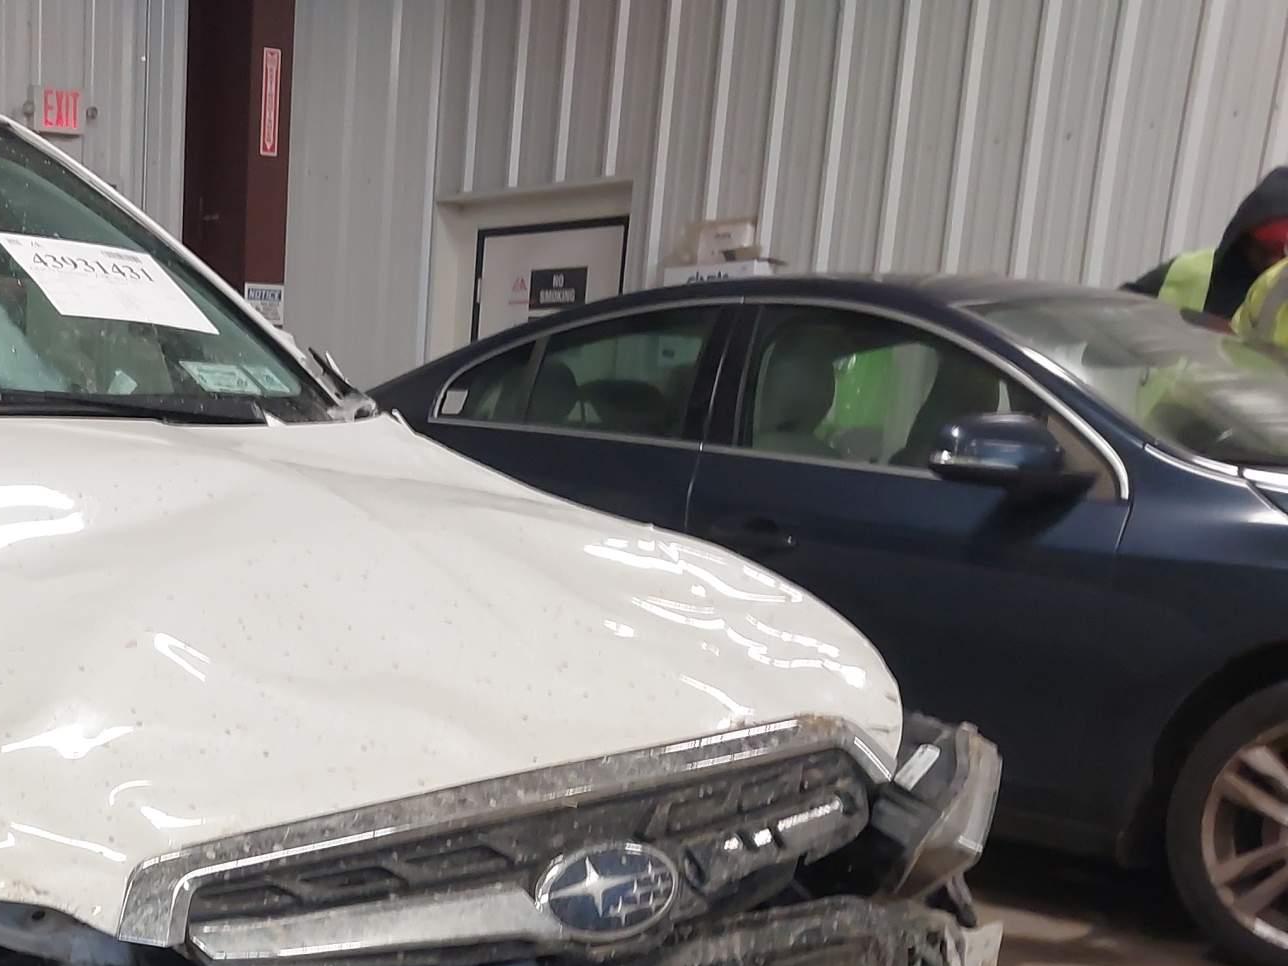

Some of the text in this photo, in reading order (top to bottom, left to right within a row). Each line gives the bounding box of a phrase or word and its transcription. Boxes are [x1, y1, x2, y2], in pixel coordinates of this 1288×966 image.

[43, 90, 80, 128] EXIT
[32, 252, 154, 282] 43931431
[552, 272, 565, 288] NO
[248, 289, 281, 300] NOTICE
[539, 288, 576, 304] SMOKING
